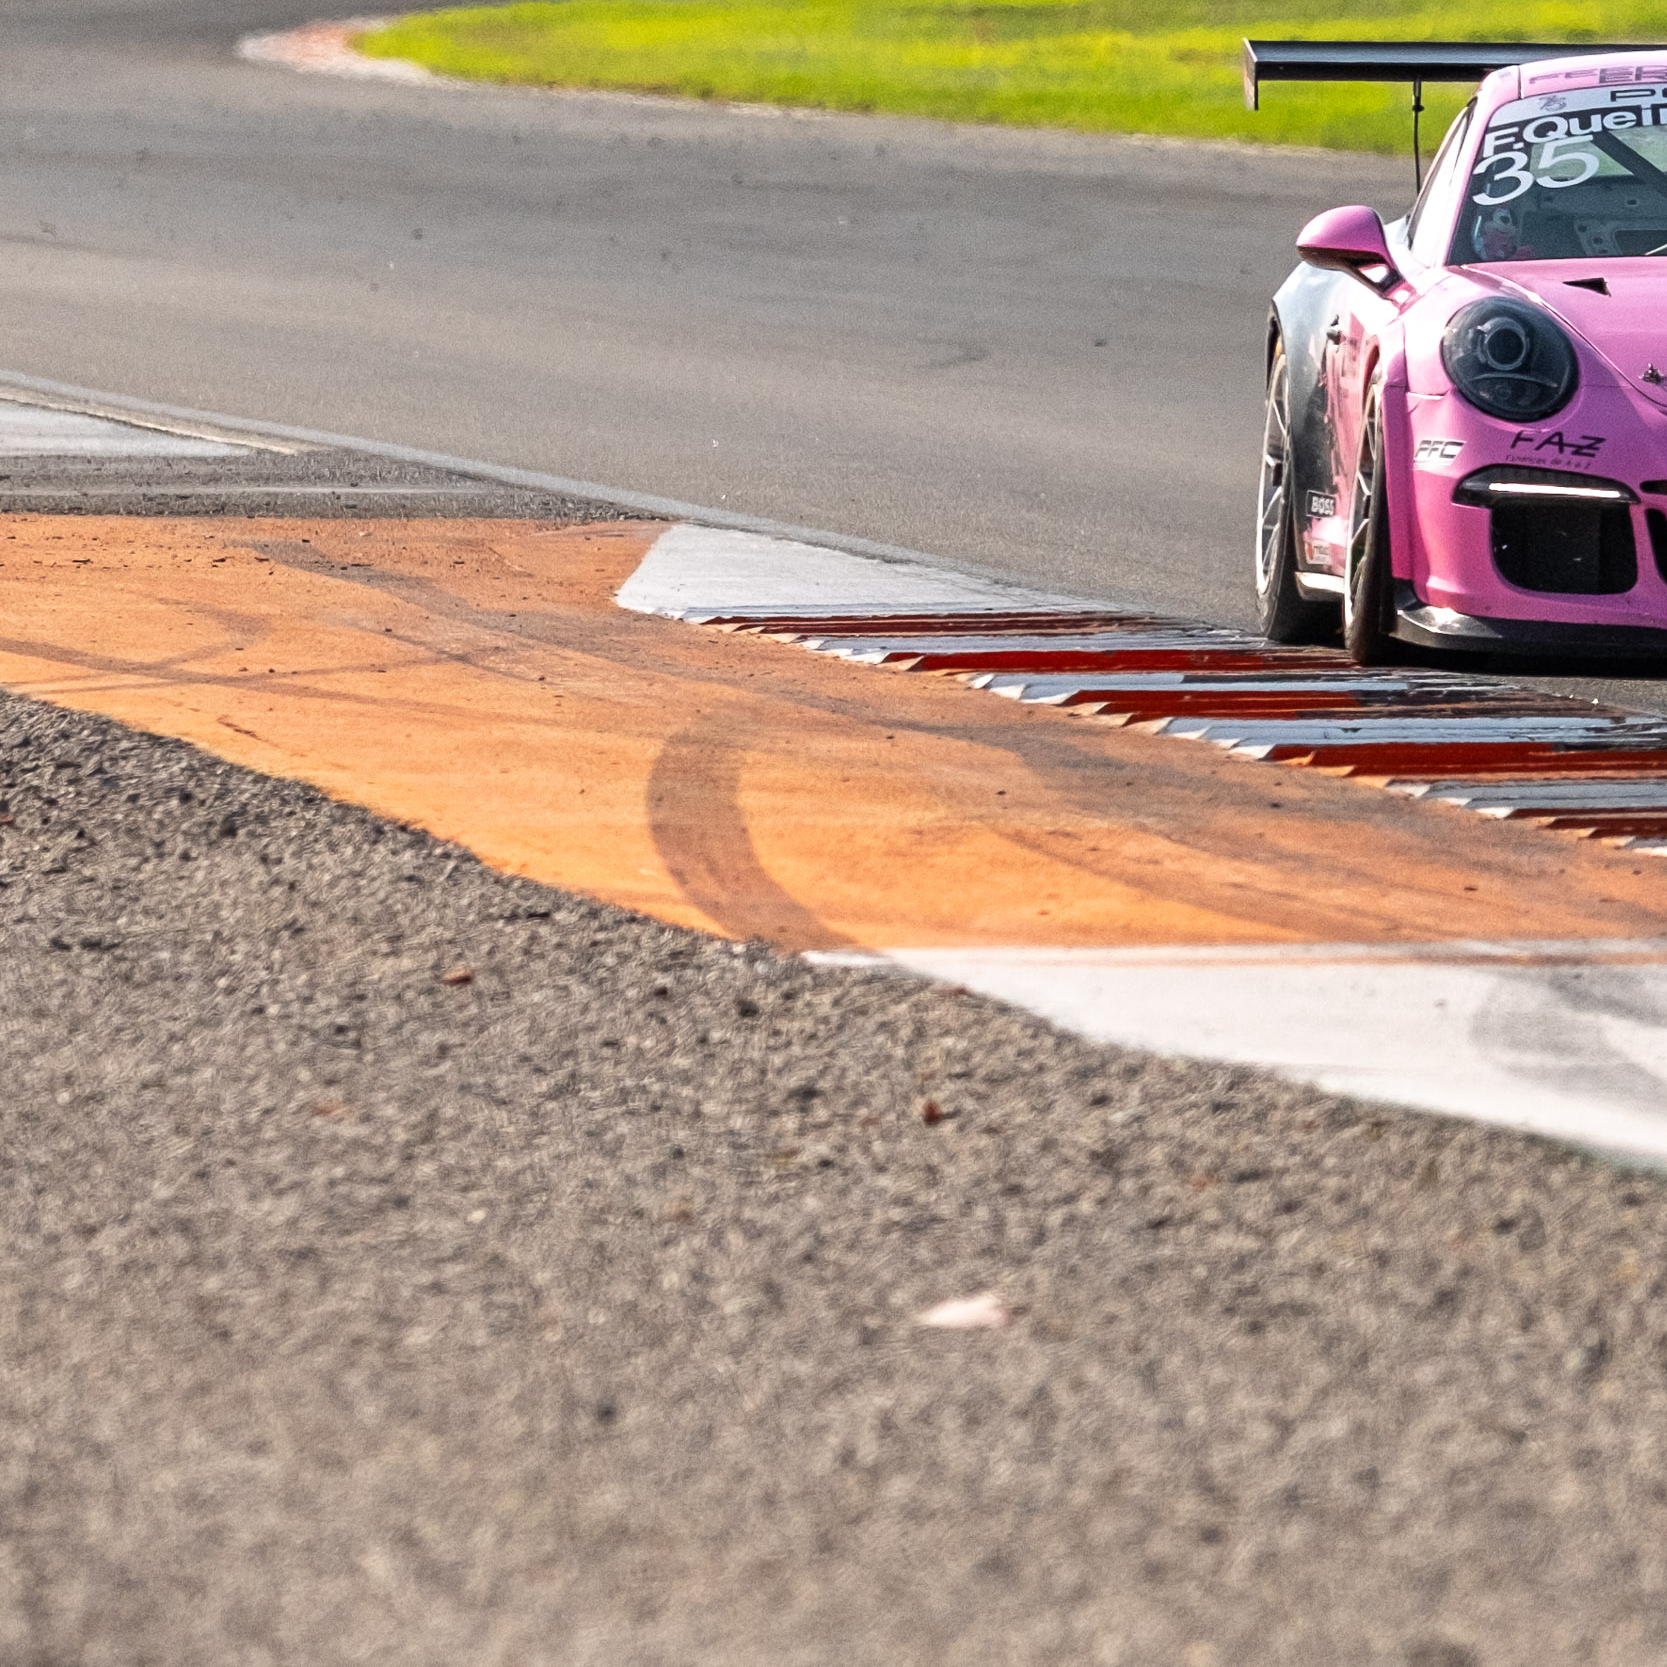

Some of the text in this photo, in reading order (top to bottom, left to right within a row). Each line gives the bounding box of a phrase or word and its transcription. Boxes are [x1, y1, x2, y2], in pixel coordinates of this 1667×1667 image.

[1472, 135, 1600, 206] 35
[1415, 440, 1465, 459] PFC
[1510, 430, 1606, 458] FAZ
